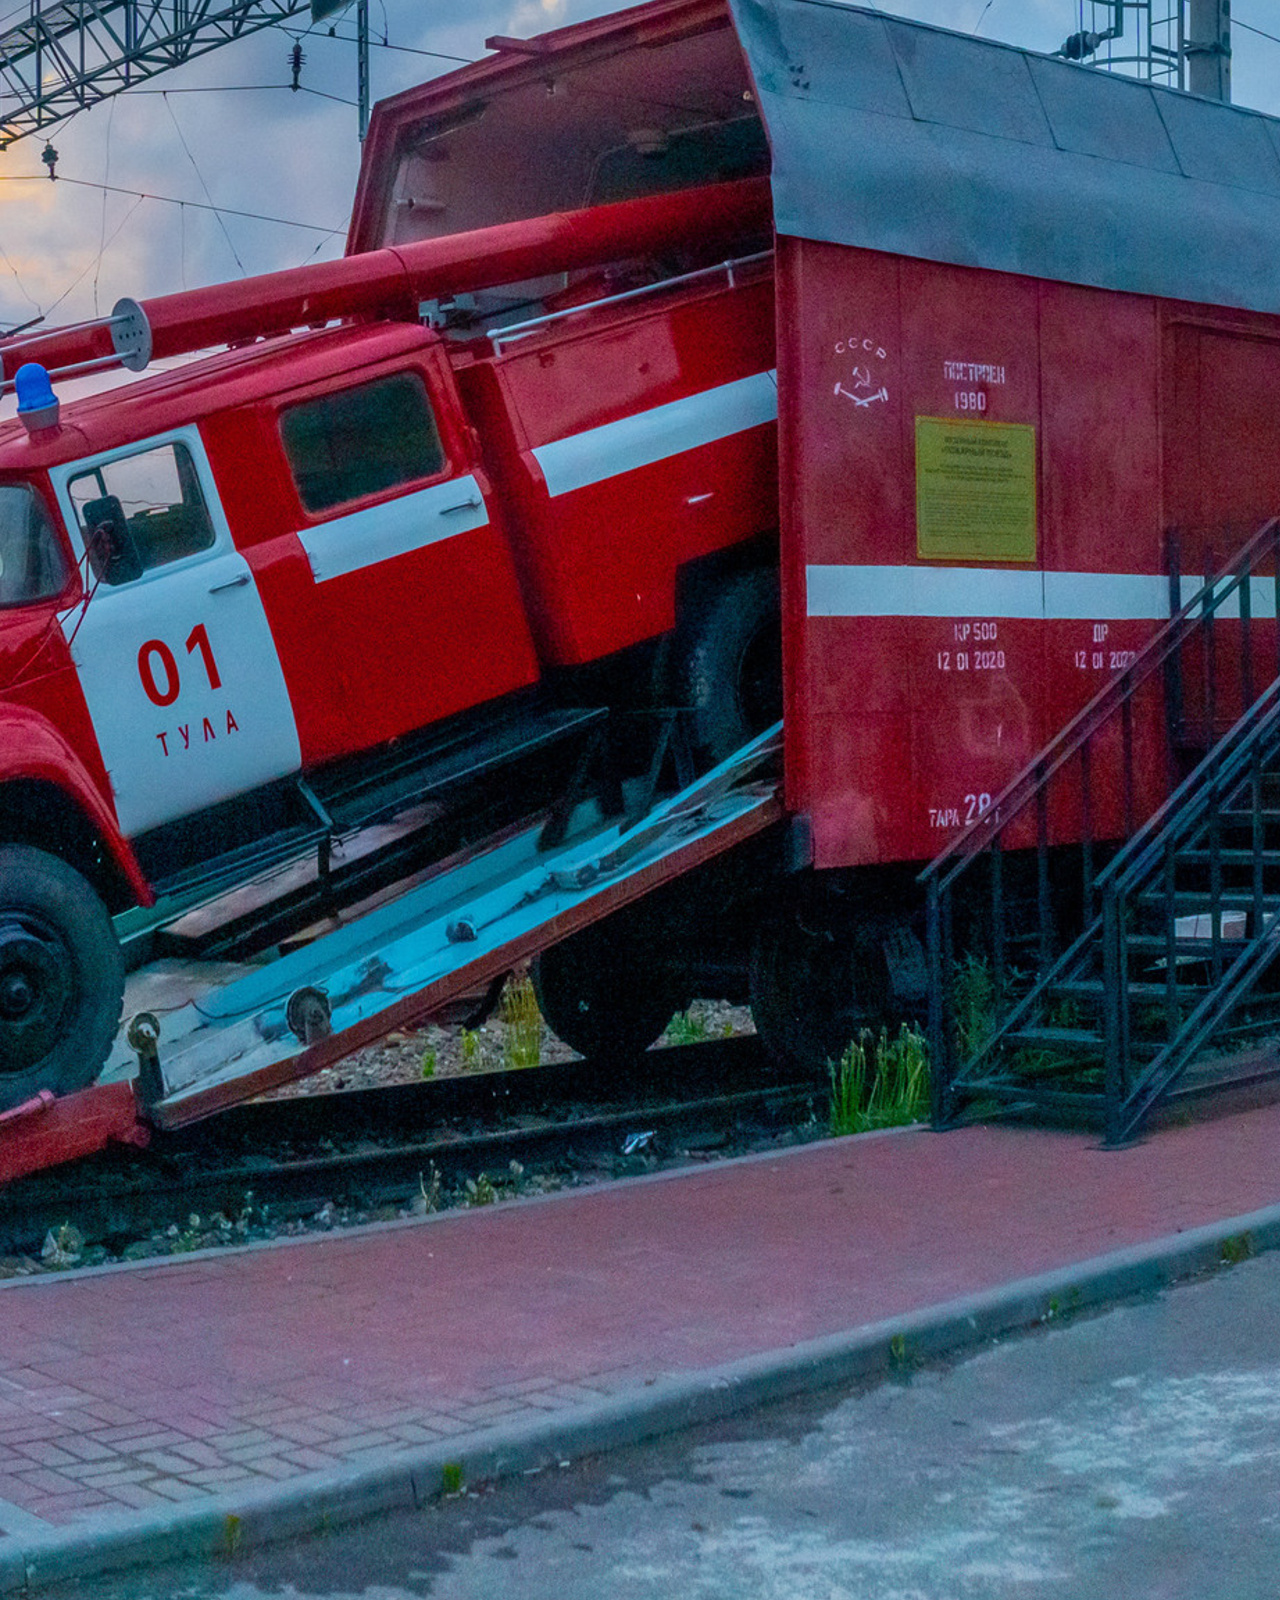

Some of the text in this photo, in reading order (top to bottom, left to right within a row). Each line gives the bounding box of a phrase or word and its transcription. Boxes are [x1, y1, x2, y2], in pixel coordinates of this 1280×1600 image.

[834, 337, 887, 359] СССР
[943, 361, 1006, 384] ПОСТРОЕН
[954, 391, 987, 411] 1980
[954, 622, 998, 642] КР 500
[1093, 623, 1109, 642] ДР
[137, 623, 222, 707] 01
[937, 651, 1005, 670] 12 01 2020
[1075, 651, 1087, 669] 12
[1092, 651, 1104, 669] 01
[156, 709, 239, 757] ТУЛА
[928, 808, 960, 828] ТАРА
